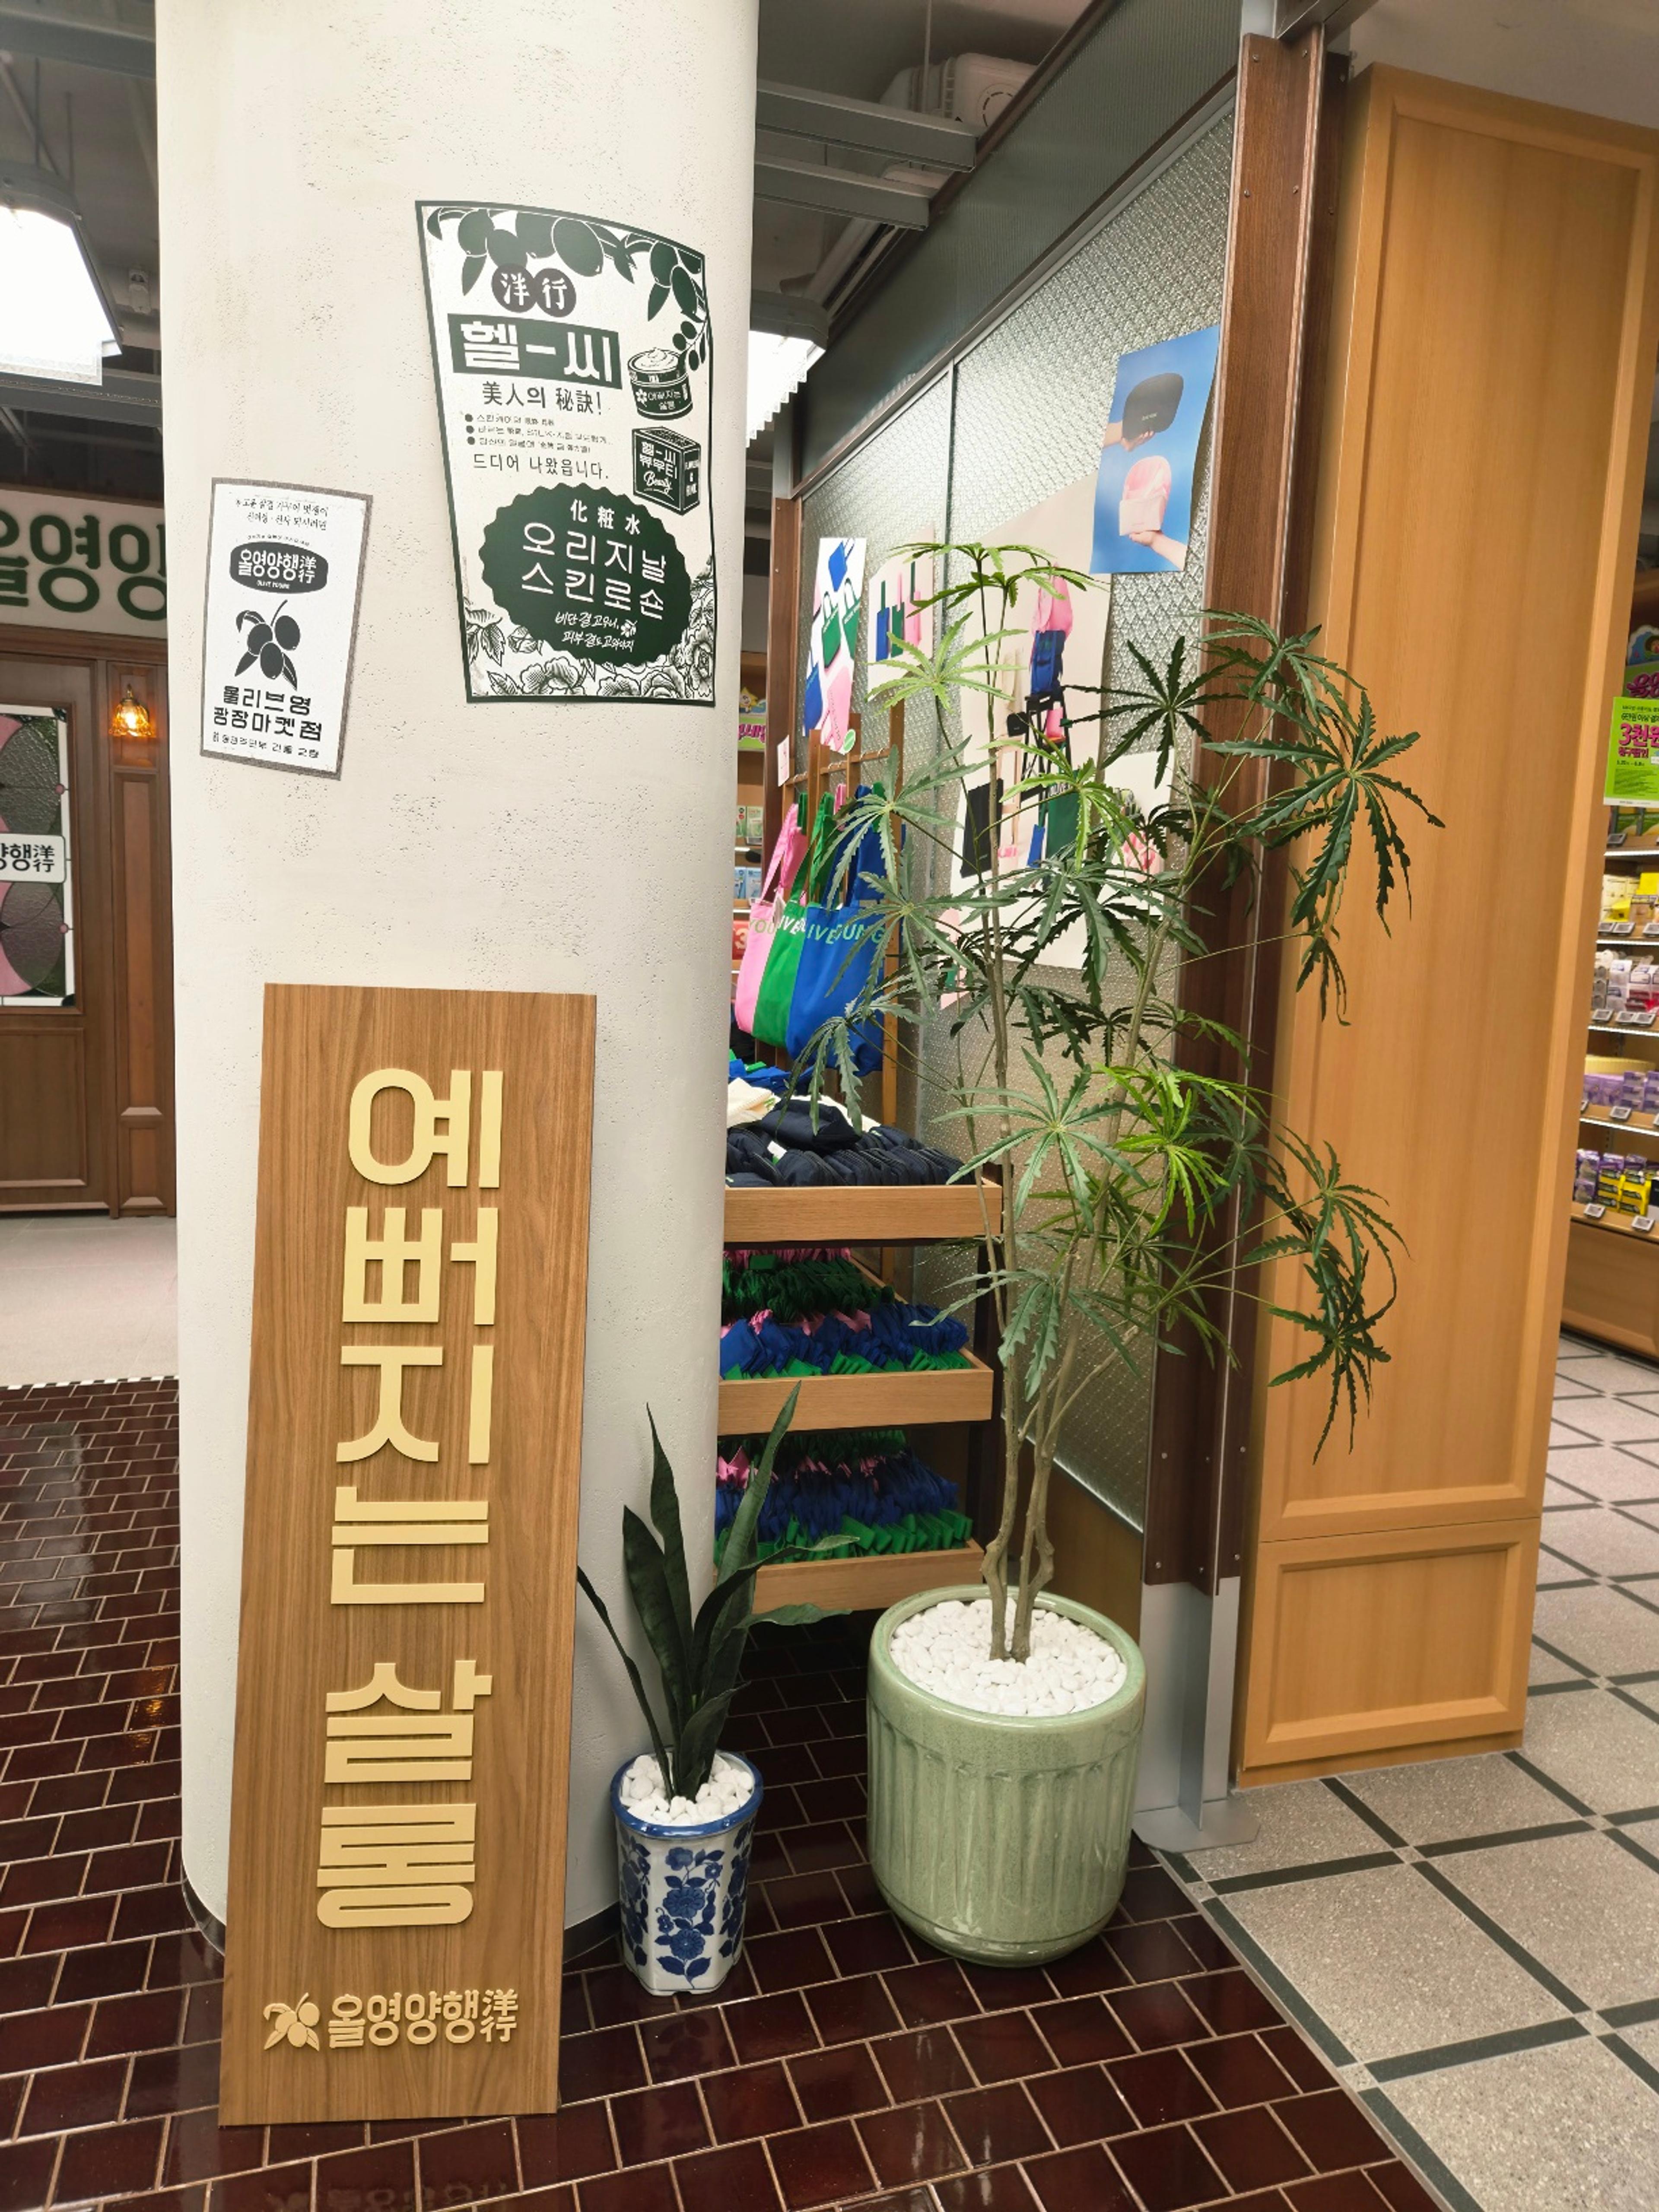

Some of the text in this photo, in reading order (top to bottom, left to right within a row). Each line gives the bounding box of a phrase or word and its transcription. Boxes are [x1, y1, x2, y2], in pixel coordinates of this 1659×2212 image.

[483, 381, 601, 415] 美人의 秘訣!
[474, 454, 608, 479] 드디어 나왔읍니다.
[570, 499, 640, 535] 化粧水
[522, 522, 666, 584] 오리지날
[521, 562, 664, 620] 스킨로숀
[223, 685, 311, 716] 올리브영
[317, 1068, 503, 1928] 예뻐지는 살롱
